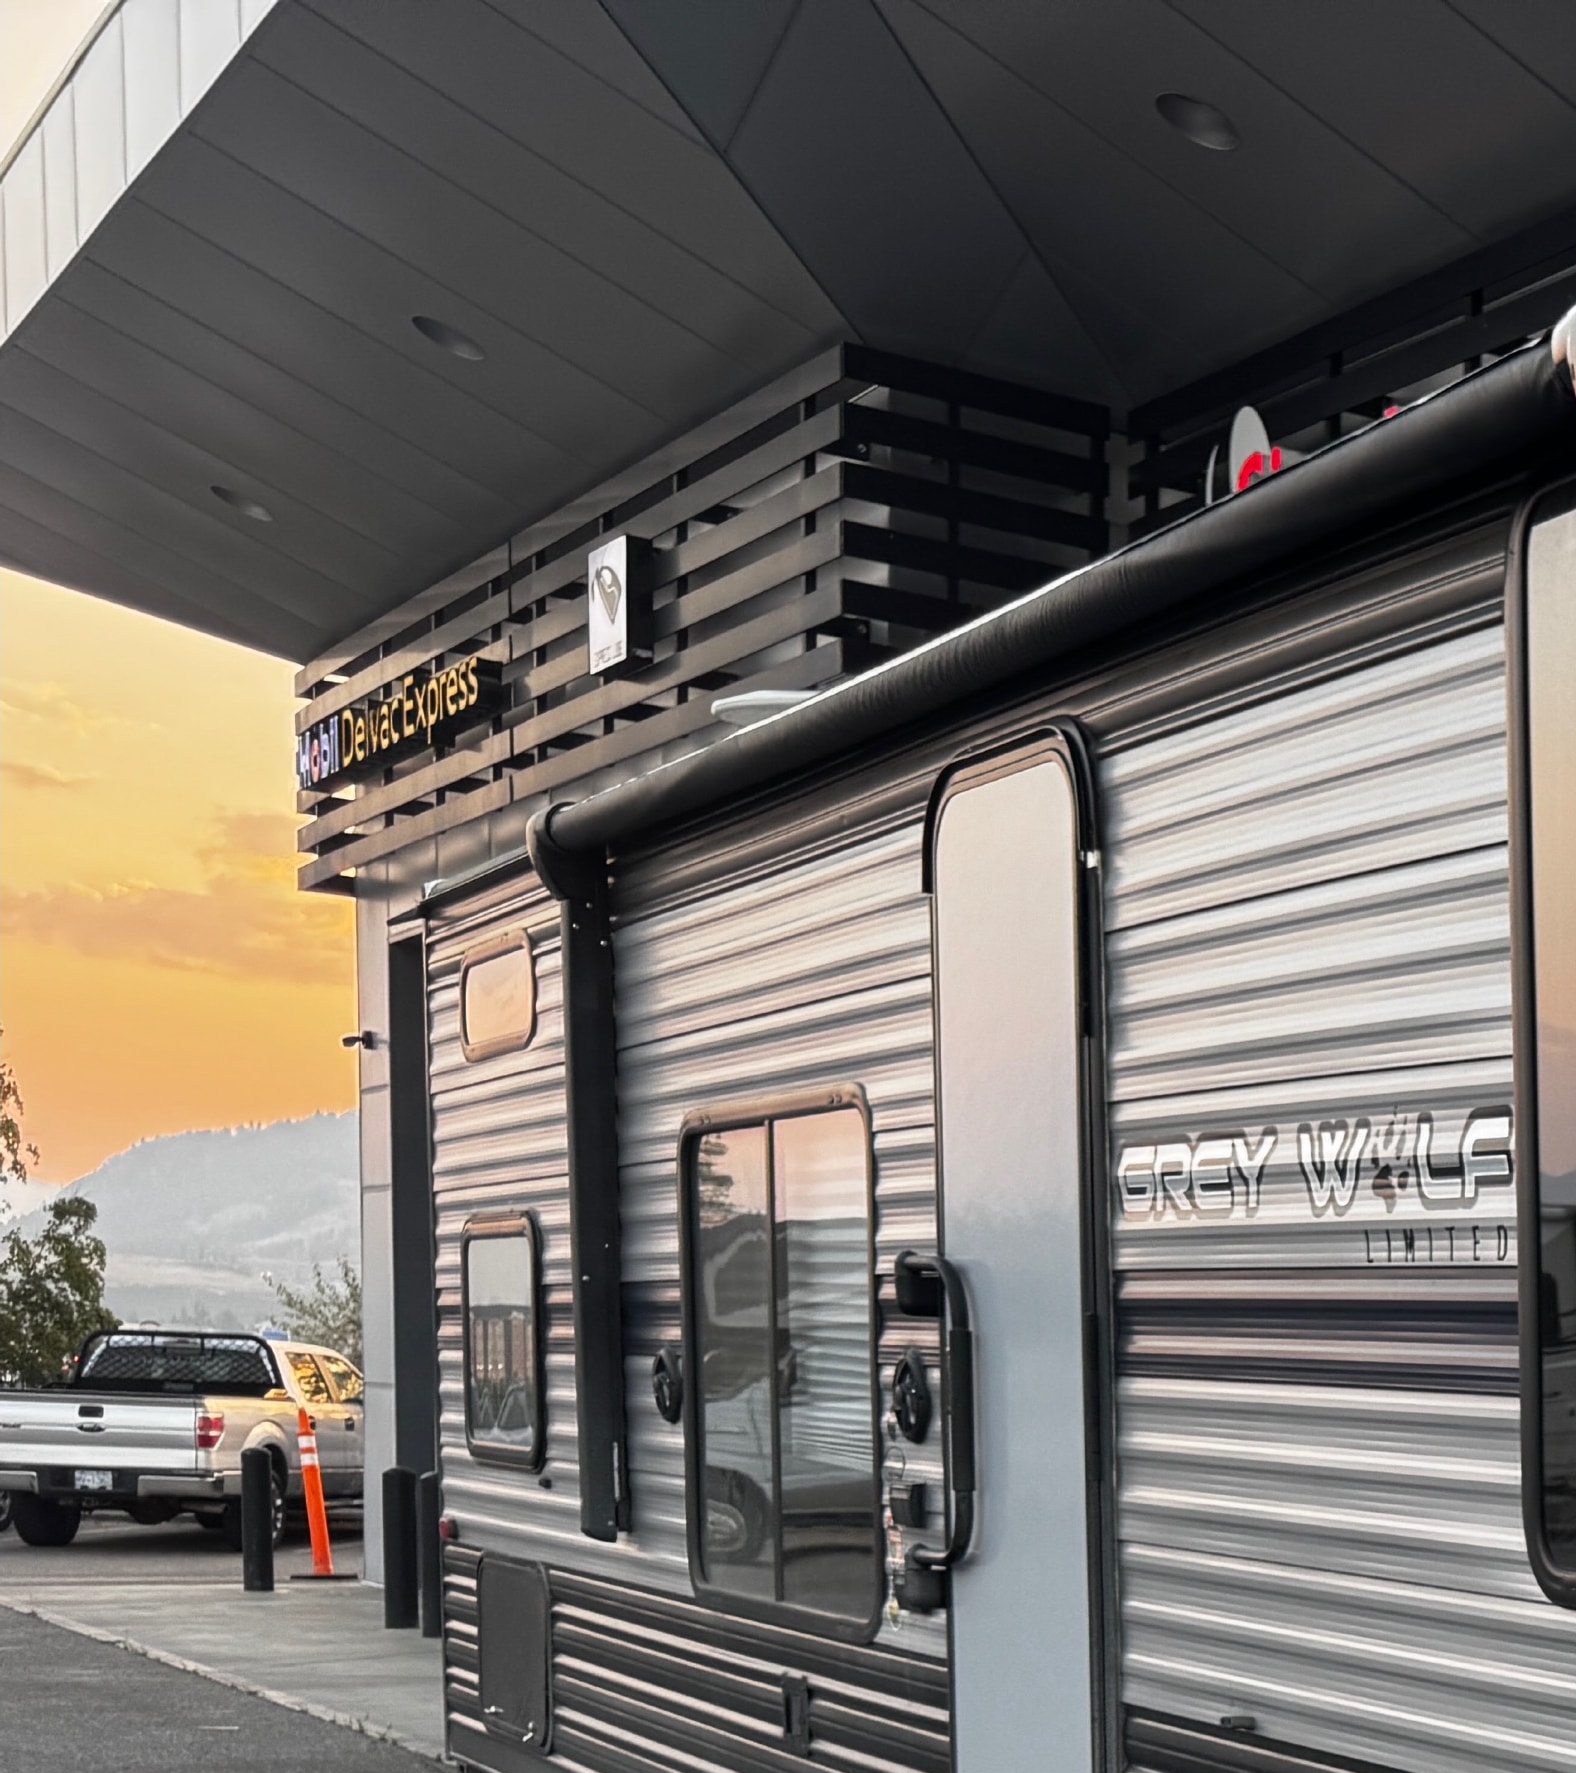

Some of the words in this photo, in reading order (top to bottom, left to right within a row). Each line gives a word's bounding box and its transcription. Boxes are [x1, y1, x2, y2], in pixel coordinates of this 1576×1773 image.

[298, 715, 340, 788] Mobil
[341, 697, 403, 768] Delvac
[403, 656, 479, 744] Express
[1117, 1126, 1278, 1221] GREY
[1364, 1224, 1510, 1264] LIMITED
